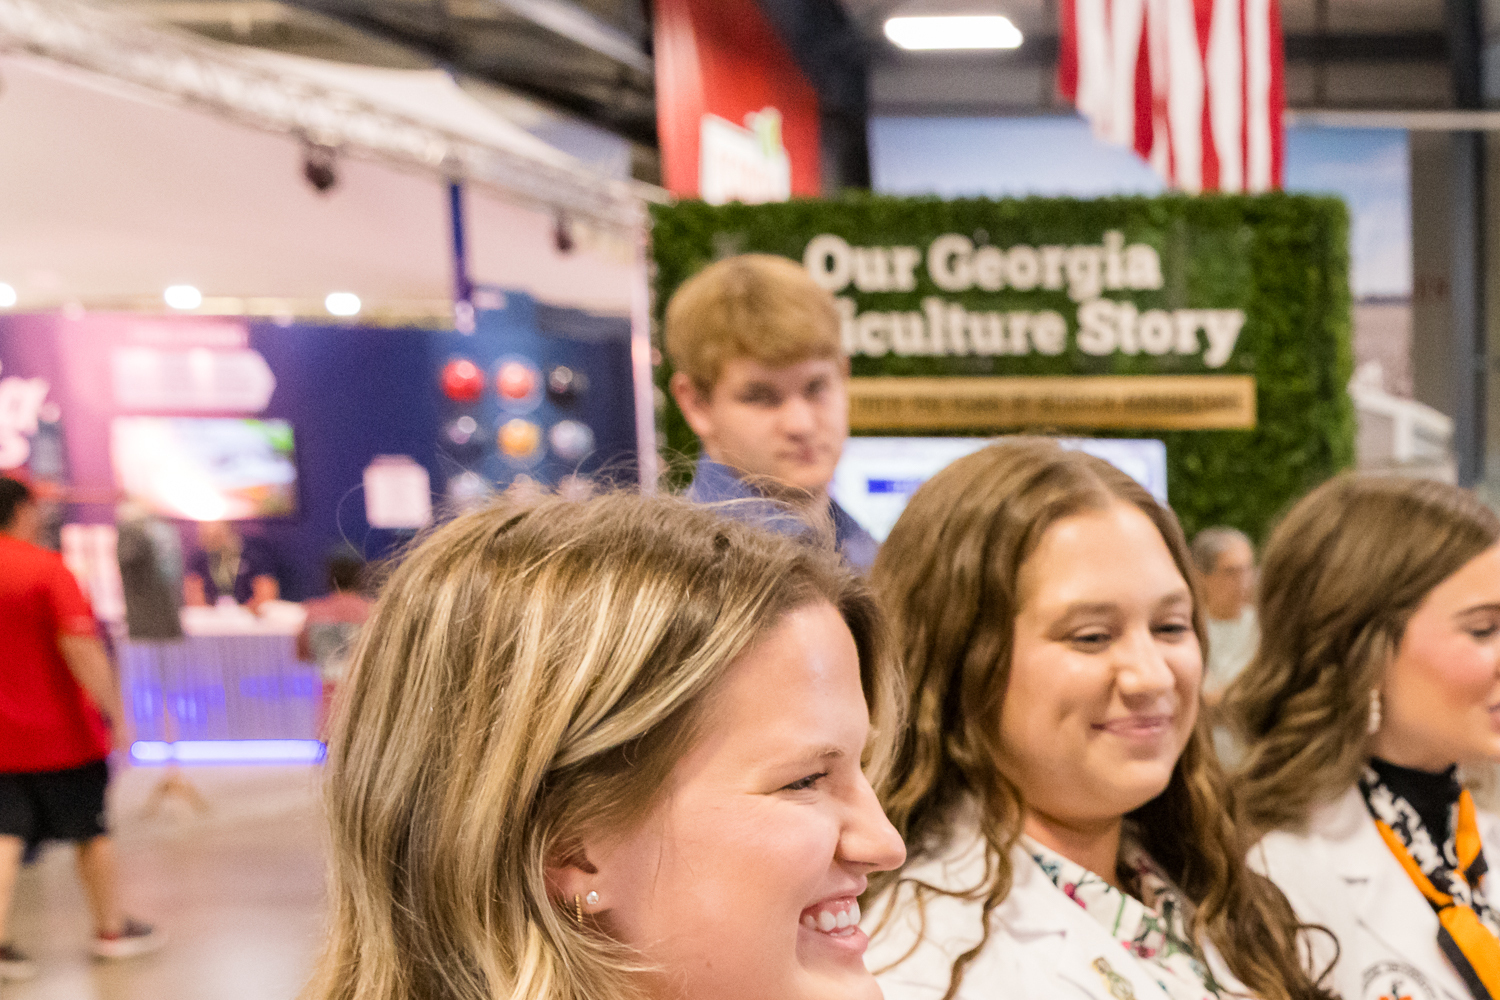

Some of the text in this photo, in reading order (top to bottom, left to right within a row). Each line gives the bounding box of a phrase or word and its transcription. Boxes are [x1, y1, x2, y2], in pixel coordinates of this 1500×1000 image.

[804, 229, 1165, 300] Our Georgia
[838, 297, 1246, 368] iculture Story
